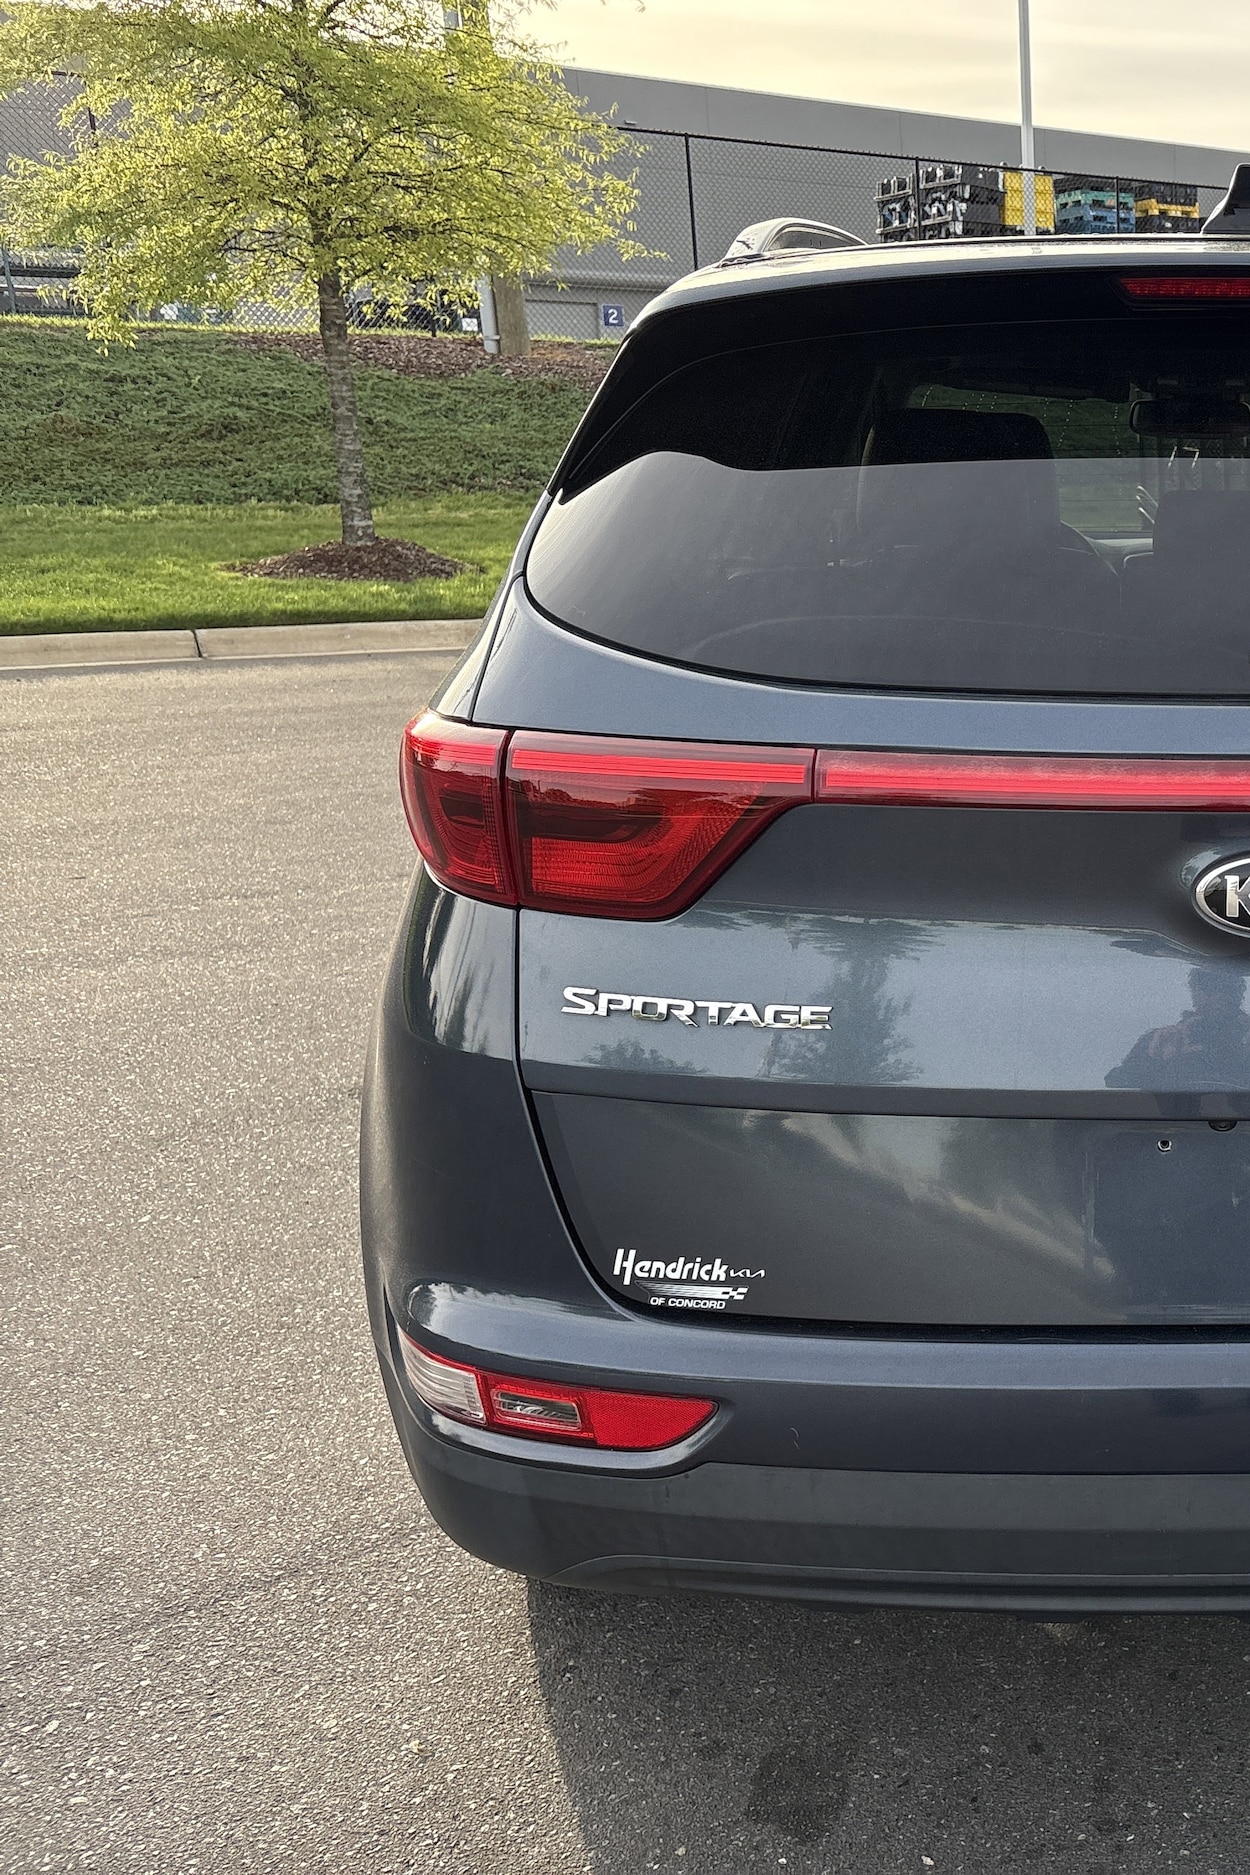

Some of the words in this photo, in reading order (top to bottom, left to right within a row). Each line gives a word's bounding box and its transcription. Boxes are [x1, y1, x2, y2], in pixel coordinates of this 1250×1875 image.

[608, 309, 619, 323] 2
[560, 986, 833, 1030] SPORTAGE
[612, 1248, 729, 1286] Hendrick
[650, 1297, 666, 1306] OF
[668, 1298, 726, 1310] CONCORD
